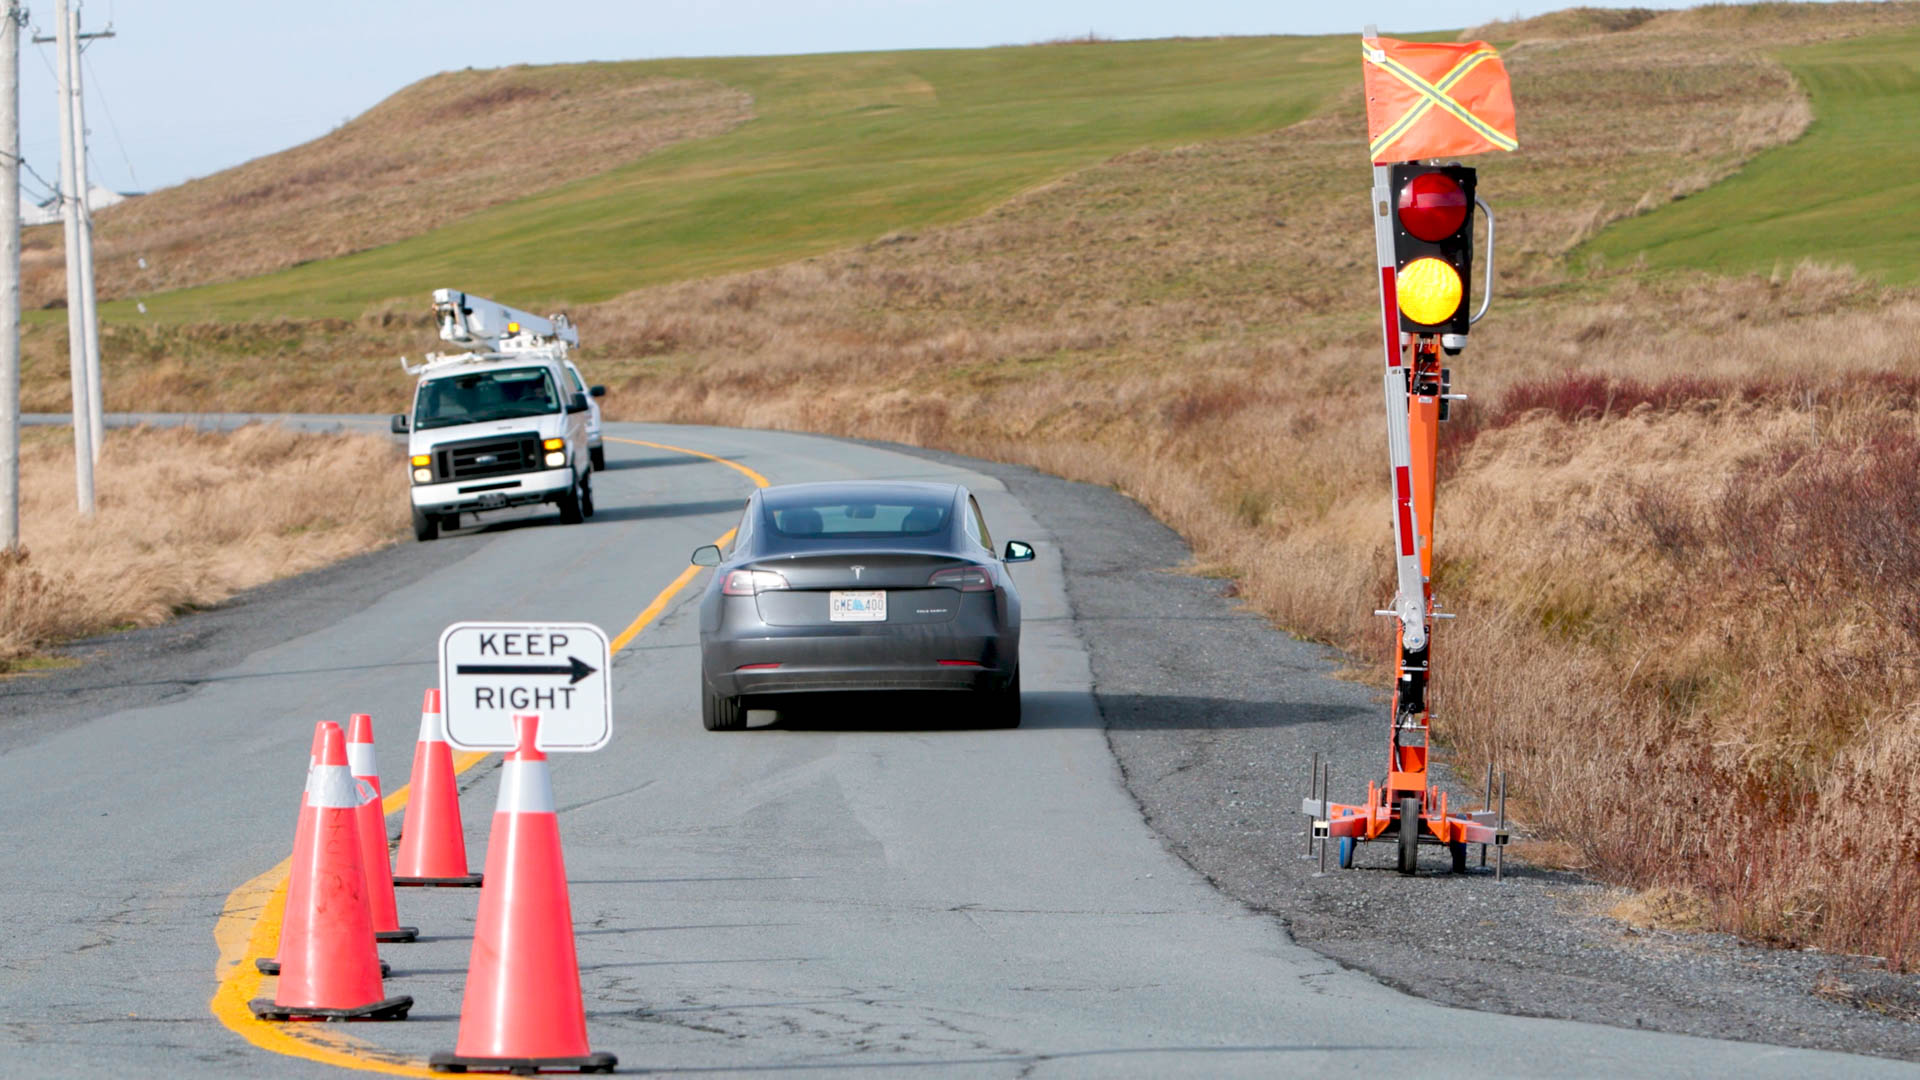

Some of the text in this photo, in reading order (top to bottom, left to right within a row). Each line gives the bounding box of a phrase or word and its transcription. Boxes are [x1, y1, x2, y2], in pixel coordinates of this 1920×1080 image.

[865, 599, 884, 611] 400
[479, 633, 569, 656] KEEP
[475, 687, 576, 710] RIGHT
